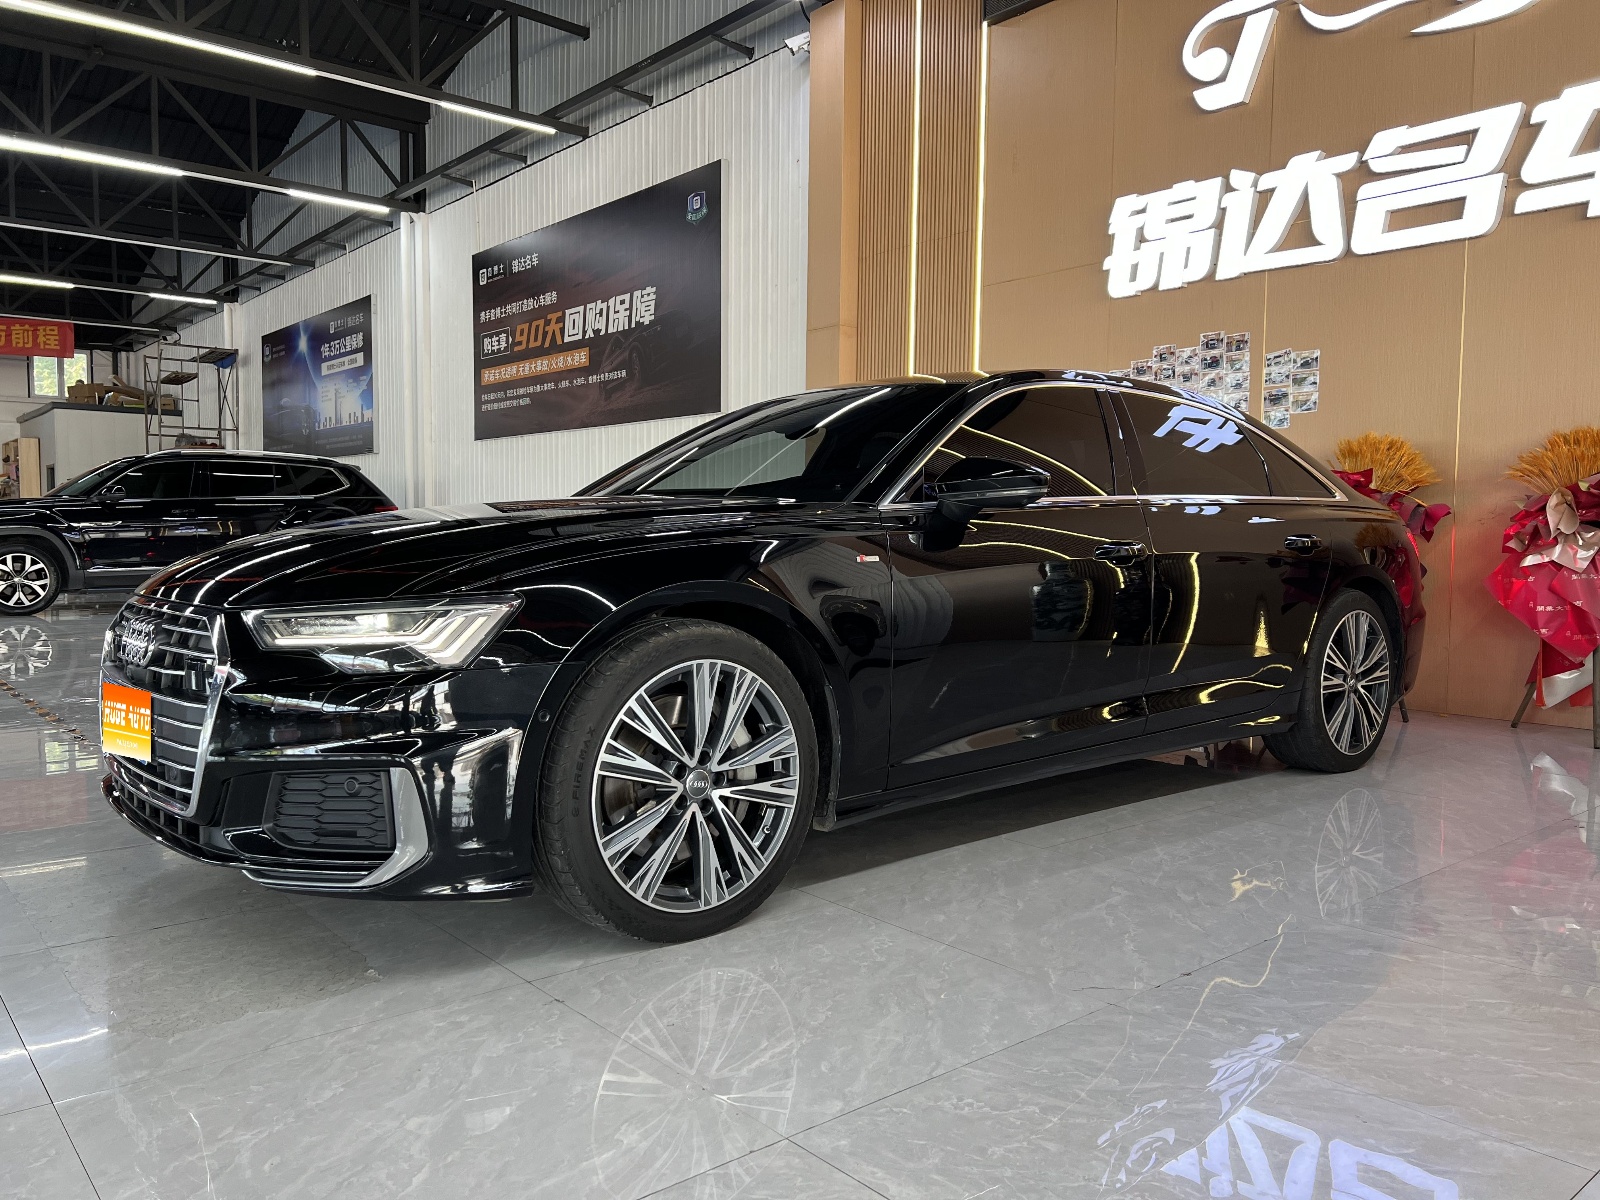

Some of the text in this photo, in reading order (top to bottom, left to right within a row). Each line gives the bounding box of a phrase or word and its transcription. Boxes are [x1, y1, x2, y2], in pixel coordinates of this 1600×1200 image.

[512, 252, 538, 273] 锦达名车
[483, 286, 657, 354] 购车享 90天回购保障
[572, 726, 596, 800] FIREMAX
